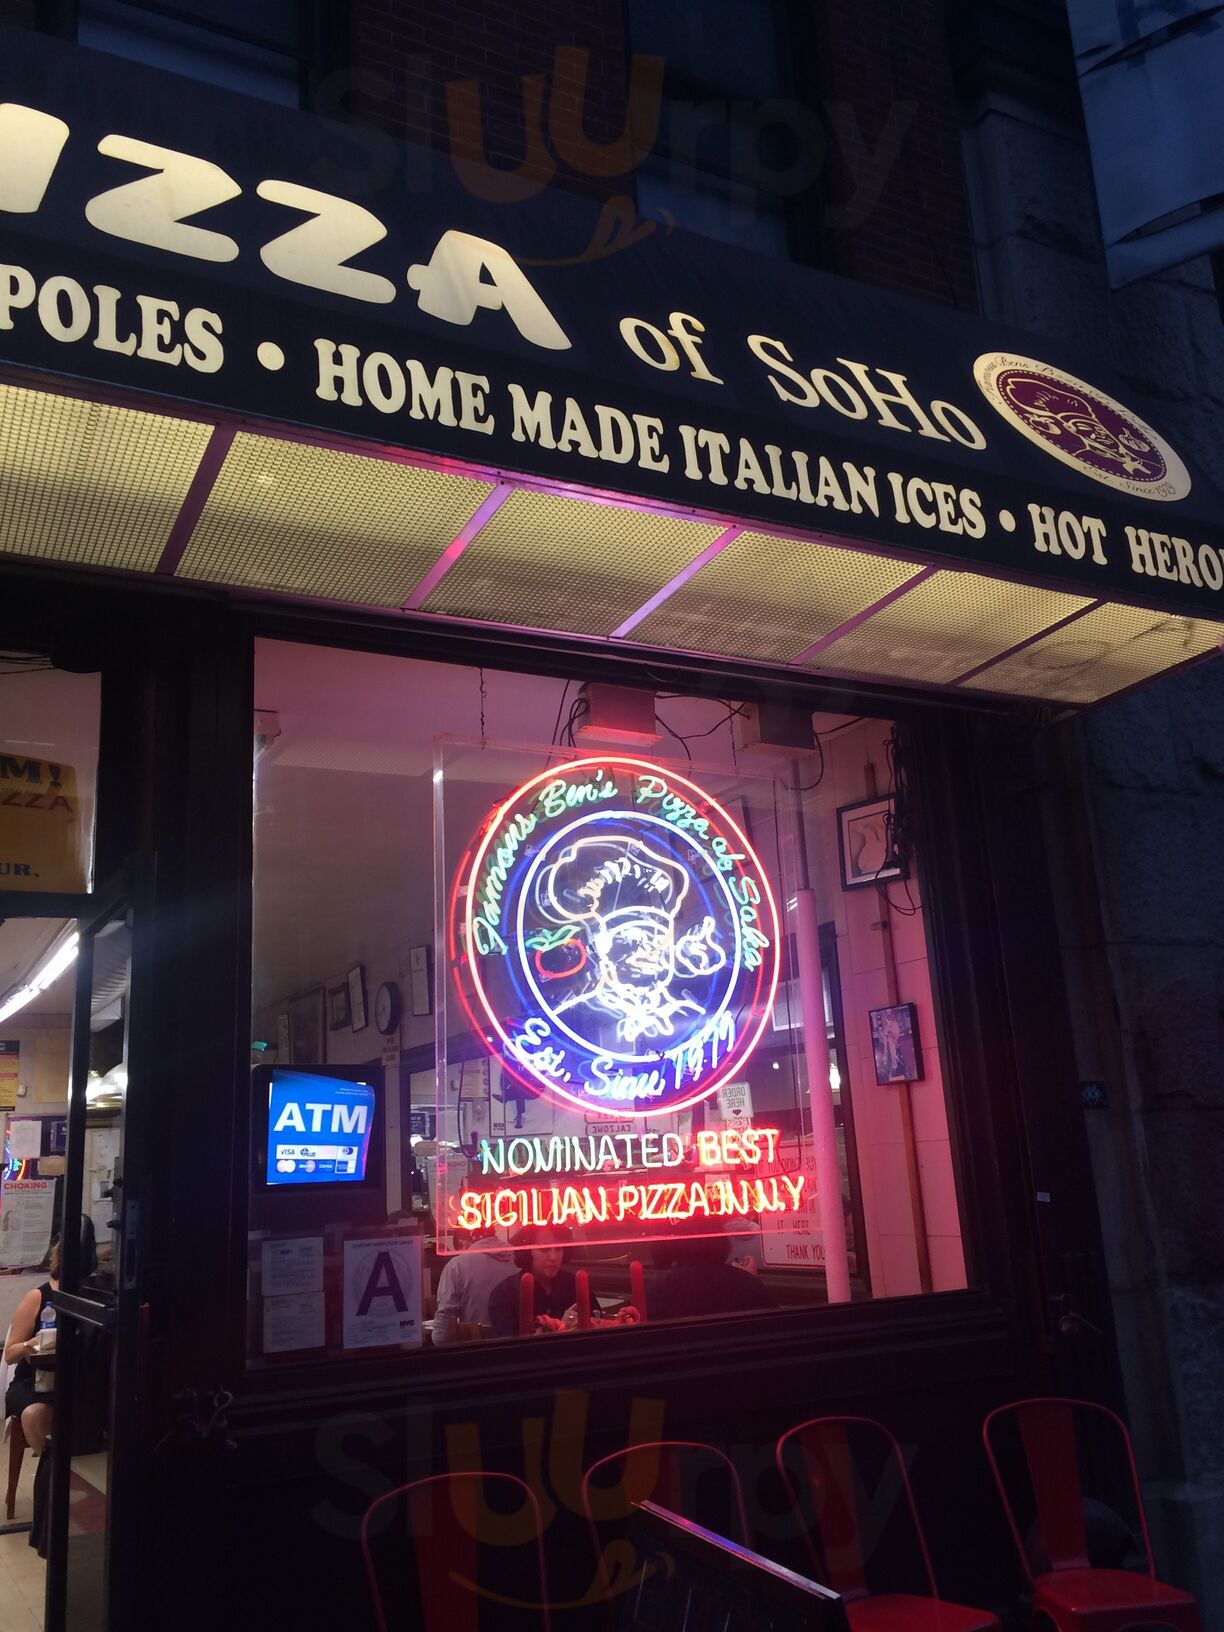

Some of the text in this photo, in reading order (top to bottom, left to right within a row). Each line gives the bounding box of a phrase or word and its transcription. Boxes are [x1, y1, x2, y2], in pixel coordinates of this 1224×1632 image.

[619, 311, 988, 450] of SoHo
[0, 264, 225, 374] POLES
[314, 338, 496, 437] HOME
[508, 383, 670, 474] MADE
[678, 424, 880, 519] ITALIAN
[887, 472, 987, 539] ICES
[1027, 503, 1108, 566] HOT
[473, 813, 538, 956] Famous
[539, 769, 618, 818] Ben's
[636, 775, 710, 841] Pizza
[273, 1102, 368, 1134] ATM
[480, 1128, 780, 1175] NOMINATED BEST
[3, 1181, 48, 1190] CHOKING
[457, 1186, 608, 1230] SICILIAN
[615, 1182, 710, 1222] PIZZA
[716, 1179, 749, 1216] IN
[786, 1244, 809, 1260] THANK
[355, 1251, 409, 1317] A
[399, 1319, 415, 1328] NYC
